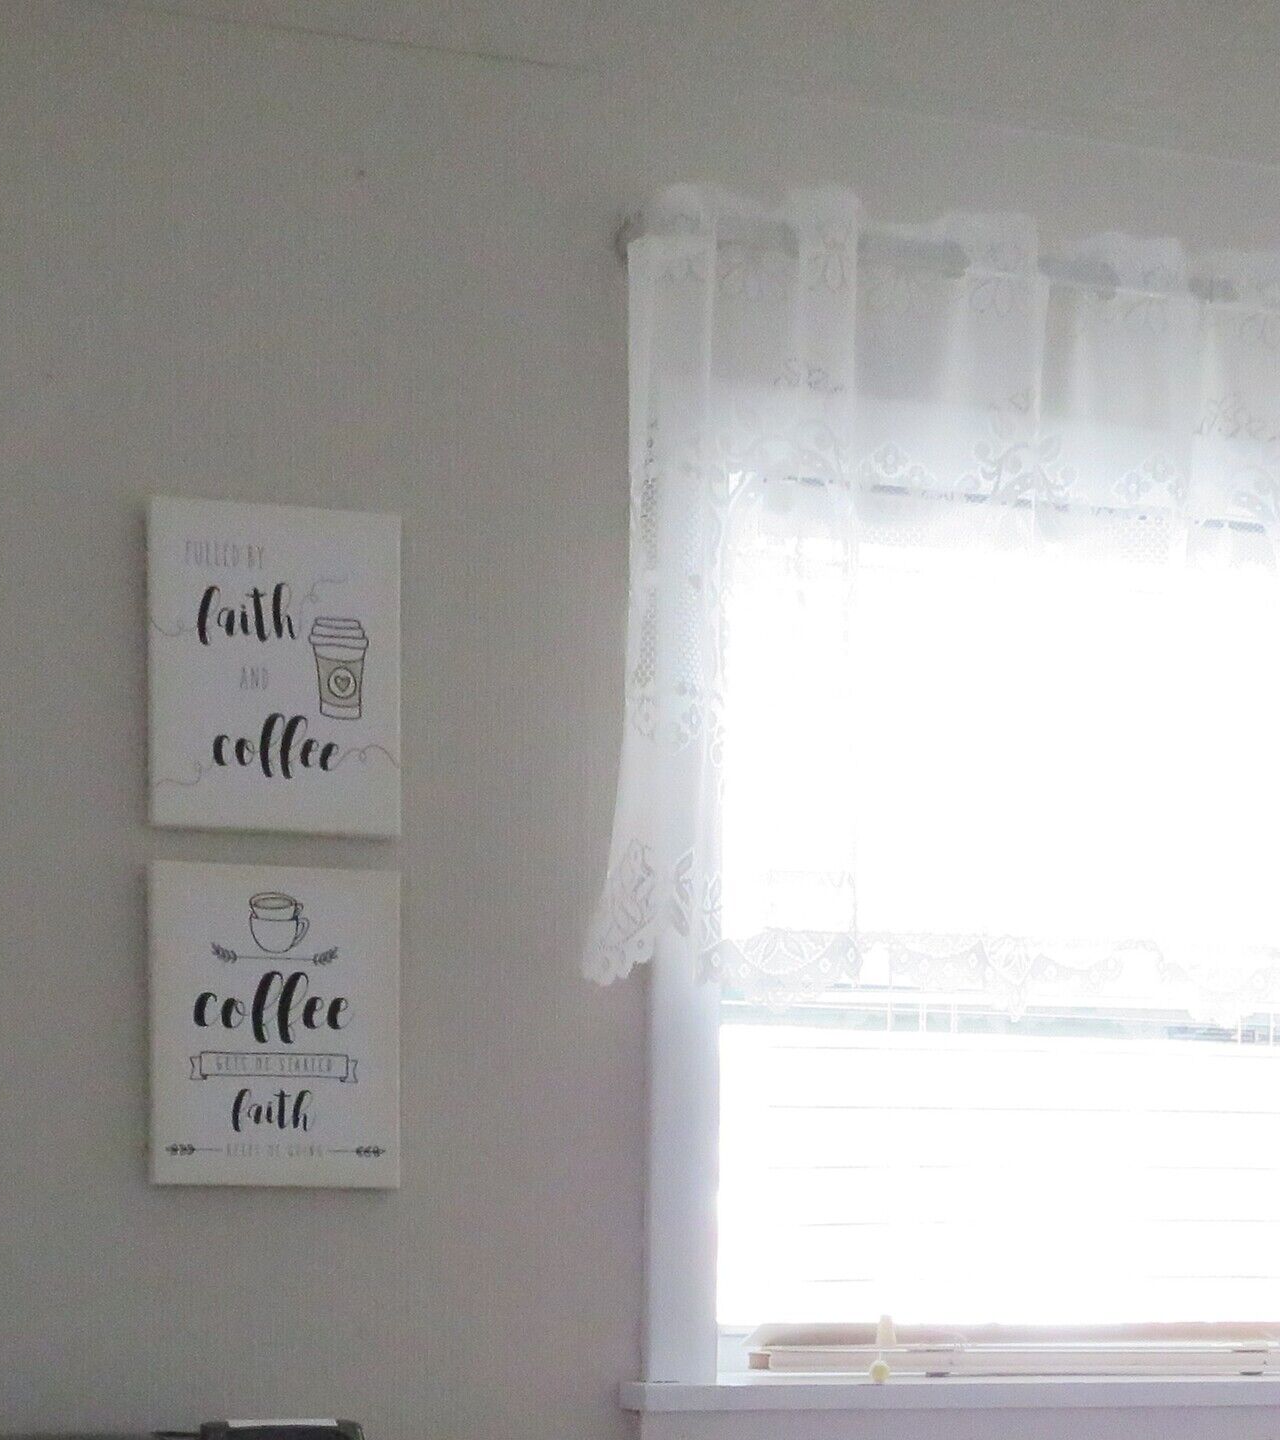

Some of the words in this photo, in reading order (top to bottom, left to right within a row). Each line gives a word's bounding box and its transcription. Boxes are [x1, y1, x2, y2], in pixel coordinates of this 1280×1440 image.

[196, 582, 297, 646] faith
[239, 665, 270, 691] AND
[212, 712, 339, 779] coffee
[192, 970, 354, 1044] coffee
[231, 1087, 314, 1133] faith
